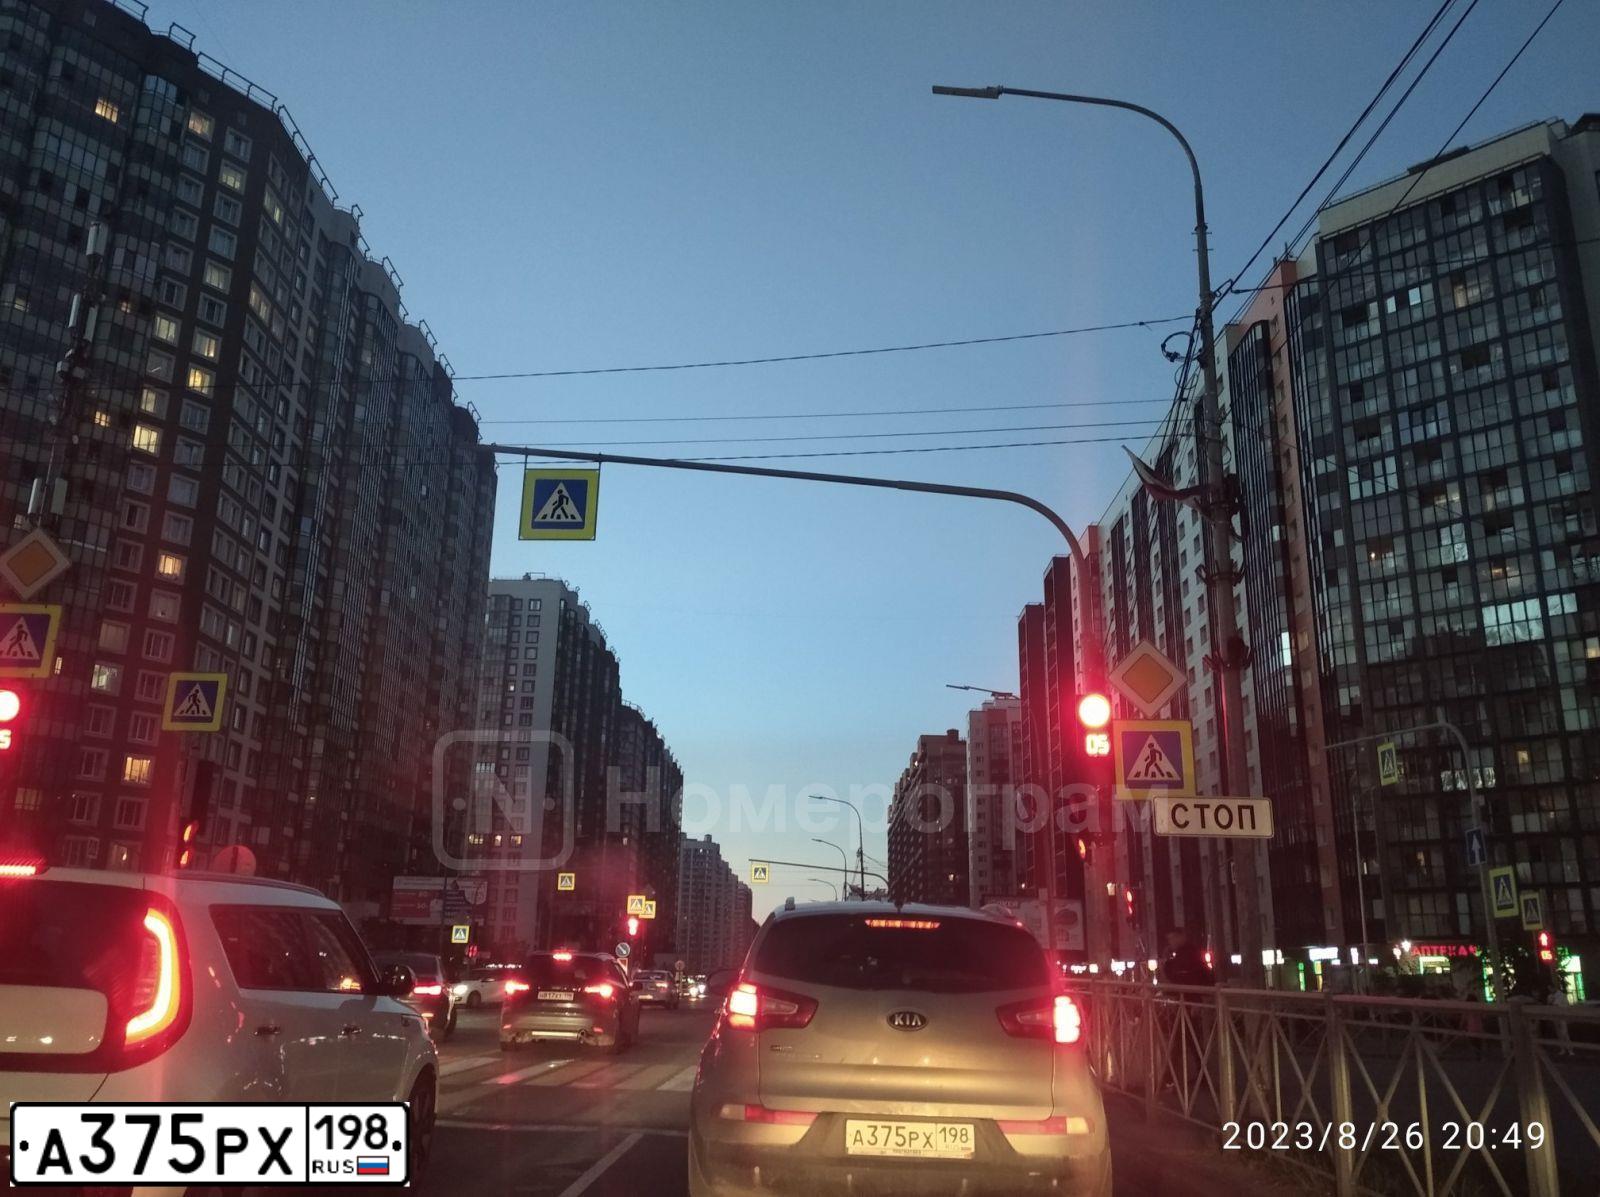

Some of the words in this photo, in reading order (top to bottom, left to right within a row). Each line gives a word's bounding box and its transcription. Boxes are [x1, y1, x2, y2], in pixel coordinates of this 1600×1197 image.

[1085, 733, 1110, 757] 05
[1170, 803, 1257, 831] СТОП
[1411, 944, 1469, 957] АПТЕКА
[894, 1013, 922, 1026] KIA
[938, 1126, 970, 1144] 198
